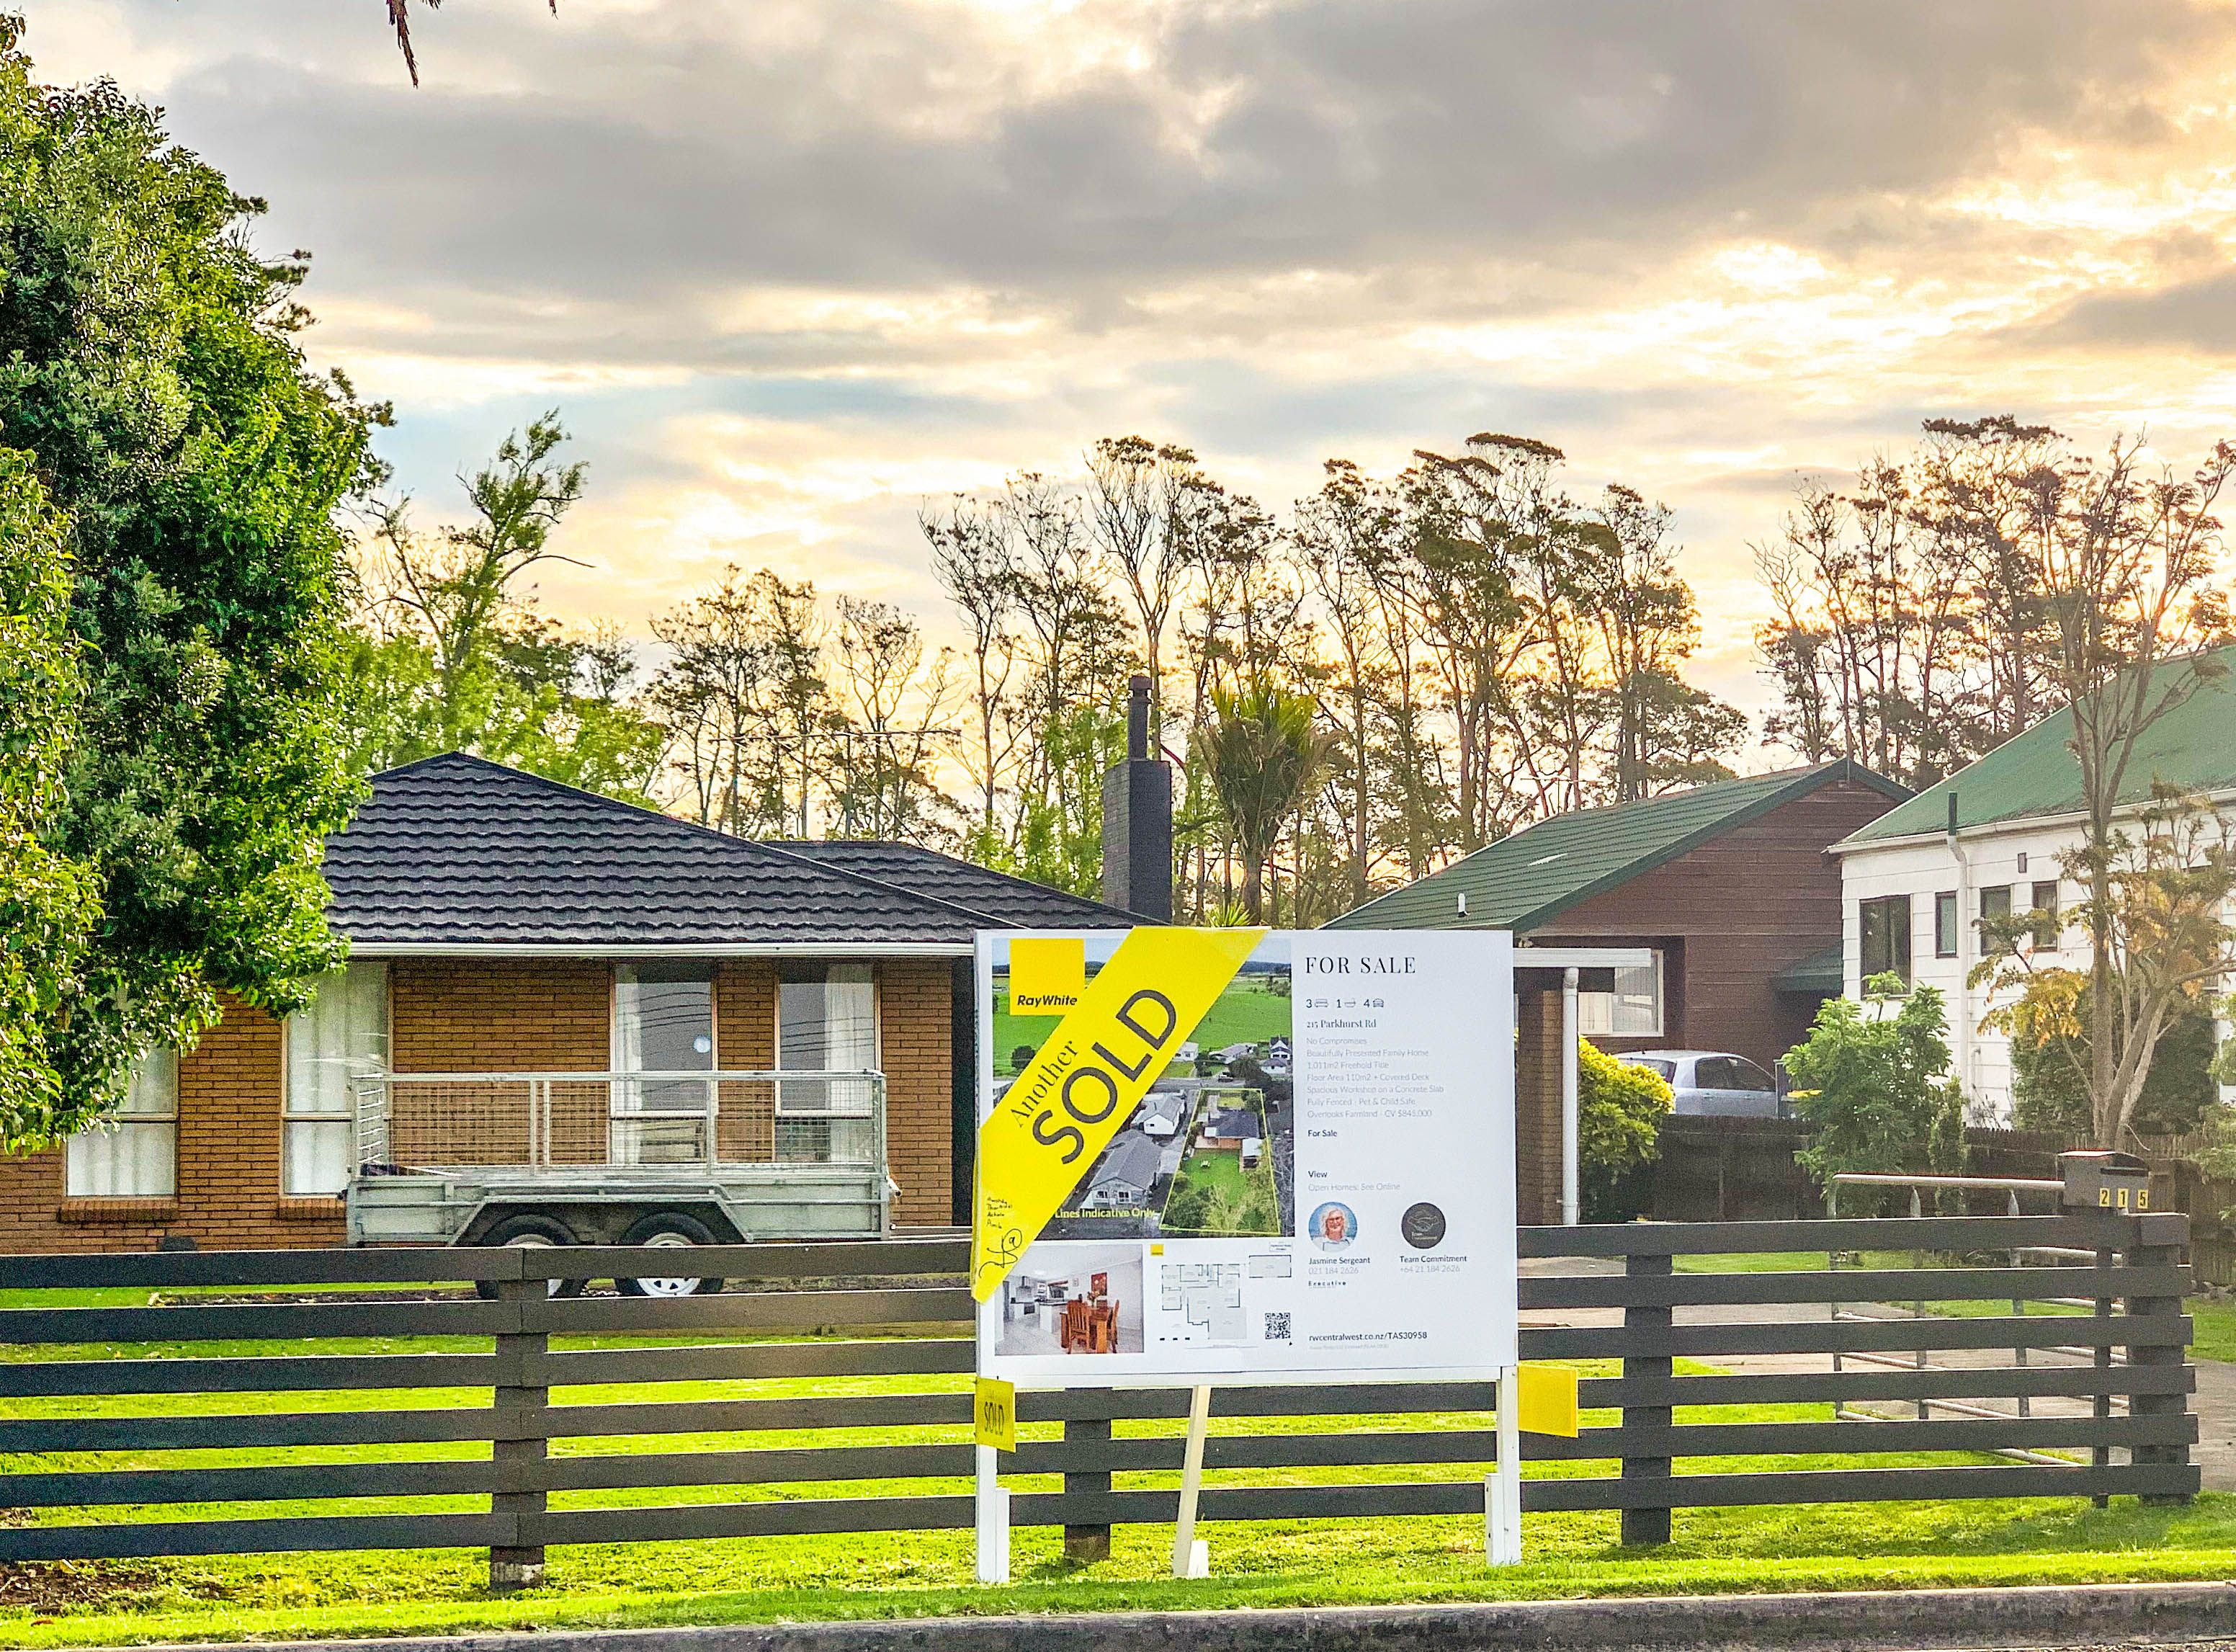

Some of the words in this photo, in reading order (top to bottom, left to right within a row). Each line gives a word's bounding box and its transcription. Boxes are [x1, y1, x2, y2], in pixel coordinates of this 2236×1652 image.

[1305, 957, 1350, 974] FOR
[1360, 957, 1416, 974] SALE
[1305, 999, 1312, 1008] 3
[1336, 999, 1341, 1008] 1
[1363, 999, 1370, 1008] 4
[1320, 1019, 1364, 1028] Parkhurst
[1364, 1019, 1377, 1028] Rd
[1383, 1049, 1405, 1058] Family
[1032, 989, 1177, 1164] SOLD
[1010, 1040, 1078, 1128] Another
[1340, 1086, 1377, 1094] Workshop
[1307, 1098, 1324, 1107] Fully
[2101, 1189, 2147, 1207] 215
[1055, 1208, 1080, 1218] Lines
[1082, 1208, 1130, 1218] Indicative
[1131, 1208, 1155, 1219] Only
[1339, 1256, 1370, 1265] Sergeant
